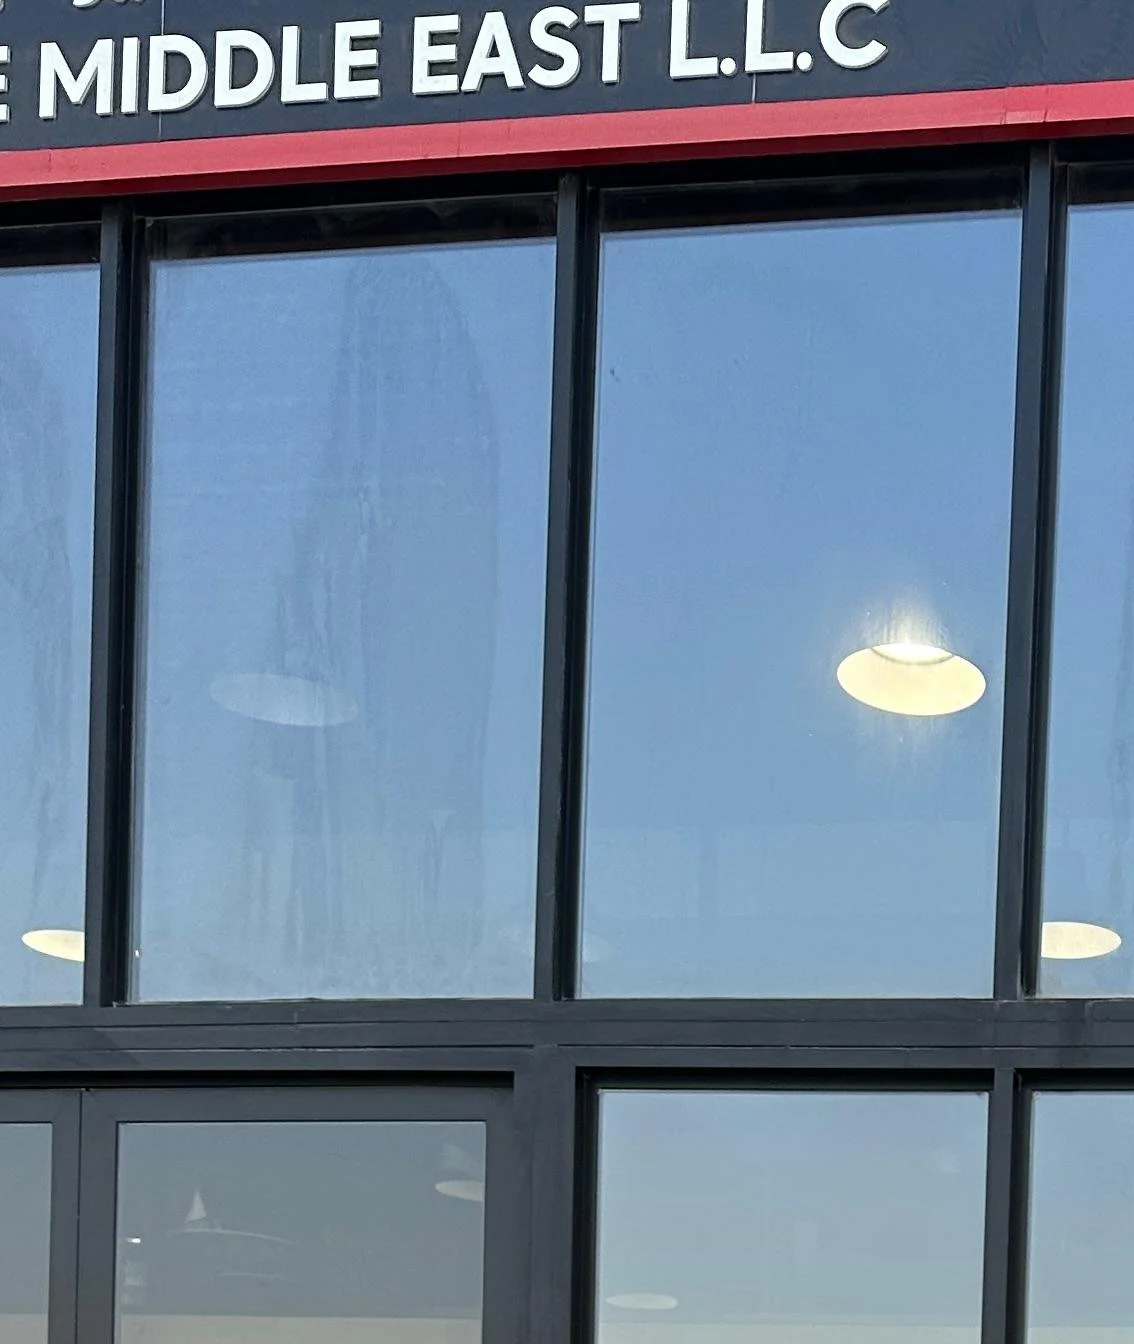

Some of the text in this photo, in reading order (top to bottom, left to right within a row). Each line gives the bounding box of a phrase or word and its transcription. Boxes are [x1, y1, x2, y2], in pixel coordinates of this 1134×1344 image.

[39, 20, 382, 120] MIDDLE
[410, 4, 641, 97] EAST
[669, 0, 891, 80] L.L.C
